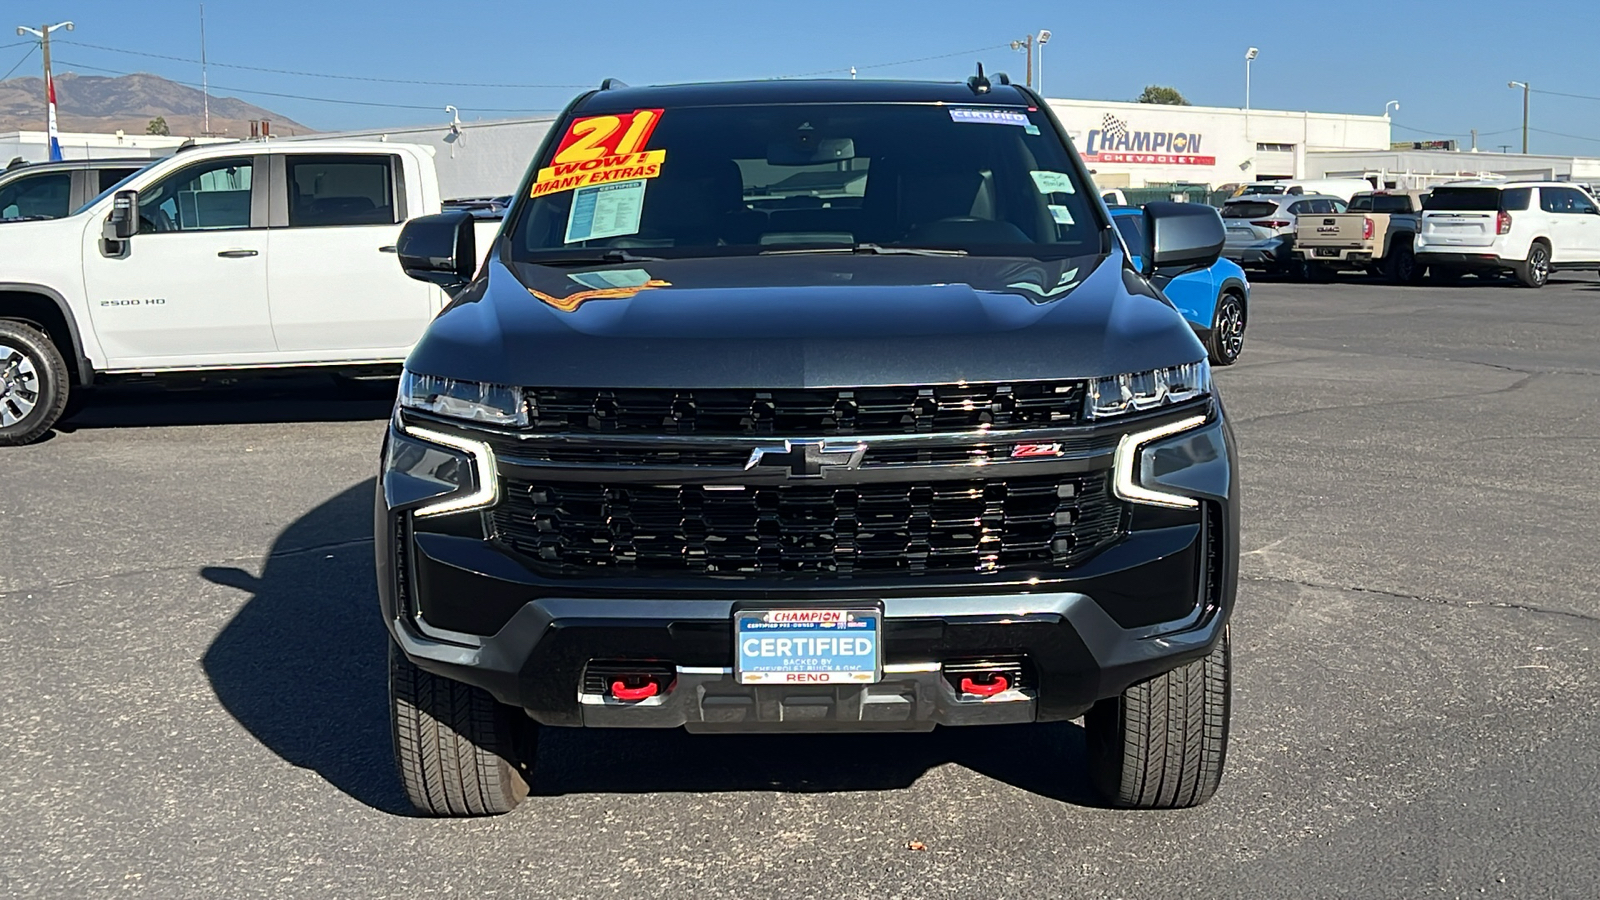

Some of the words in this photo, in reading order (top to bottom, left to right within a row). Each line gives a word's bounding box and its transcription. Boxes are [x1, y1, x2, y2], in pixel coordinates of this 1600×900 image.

[953, 111, 1025, 121] CERTIFIED
[555, 111, 656, 163] 21
[1086, 129, 1202, 156] CHAMPION
[1103, 154, 1196, 163] CHEVROLET
[554, 154, 630, 176] WOW
[533, 174, 586, 195] MANY
[589, 165, 657, 183] EXTRAS
[599, 183, 640, 192] CERTIFIED
[774, 612, 841, 622] CHAMPION
[743, 638, 872, 657] CERTIFIED
[783, 658, 818, 666] BACKED
[821, 658, 833, 666] BY
[786, 673, 830, 682] RENO
